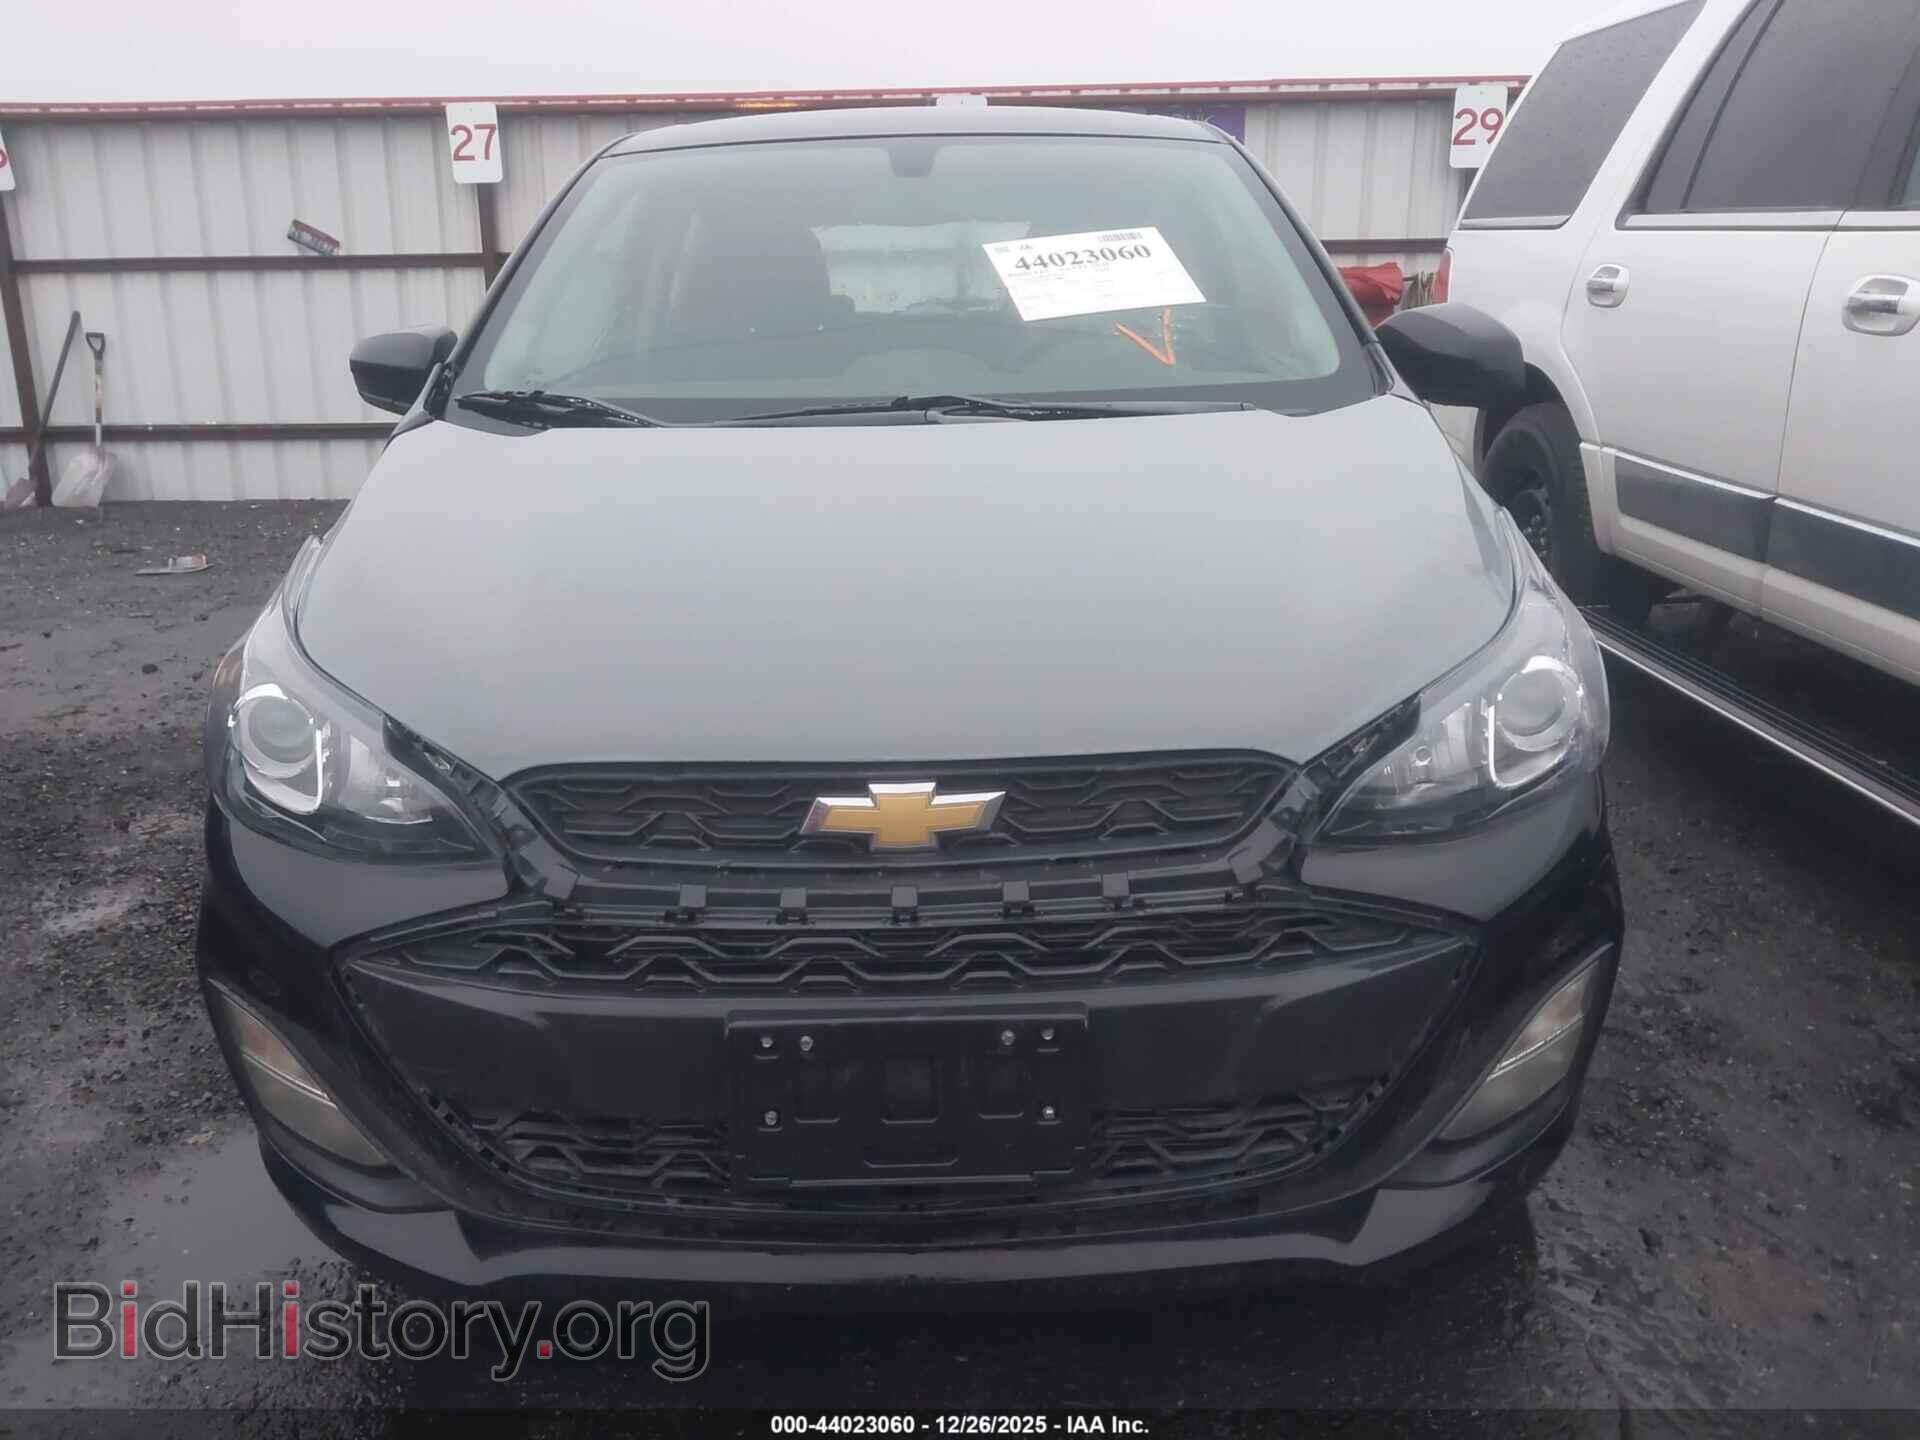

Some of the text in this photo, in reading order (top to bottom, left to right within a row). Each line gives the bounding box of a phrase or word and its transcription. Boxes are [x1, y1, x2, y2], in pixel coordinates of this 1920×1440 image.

[450, 123, 497, 161] 27
[1453, 107, 1504, 145] 29
[1014, 244, 1152, 271] 44023060
